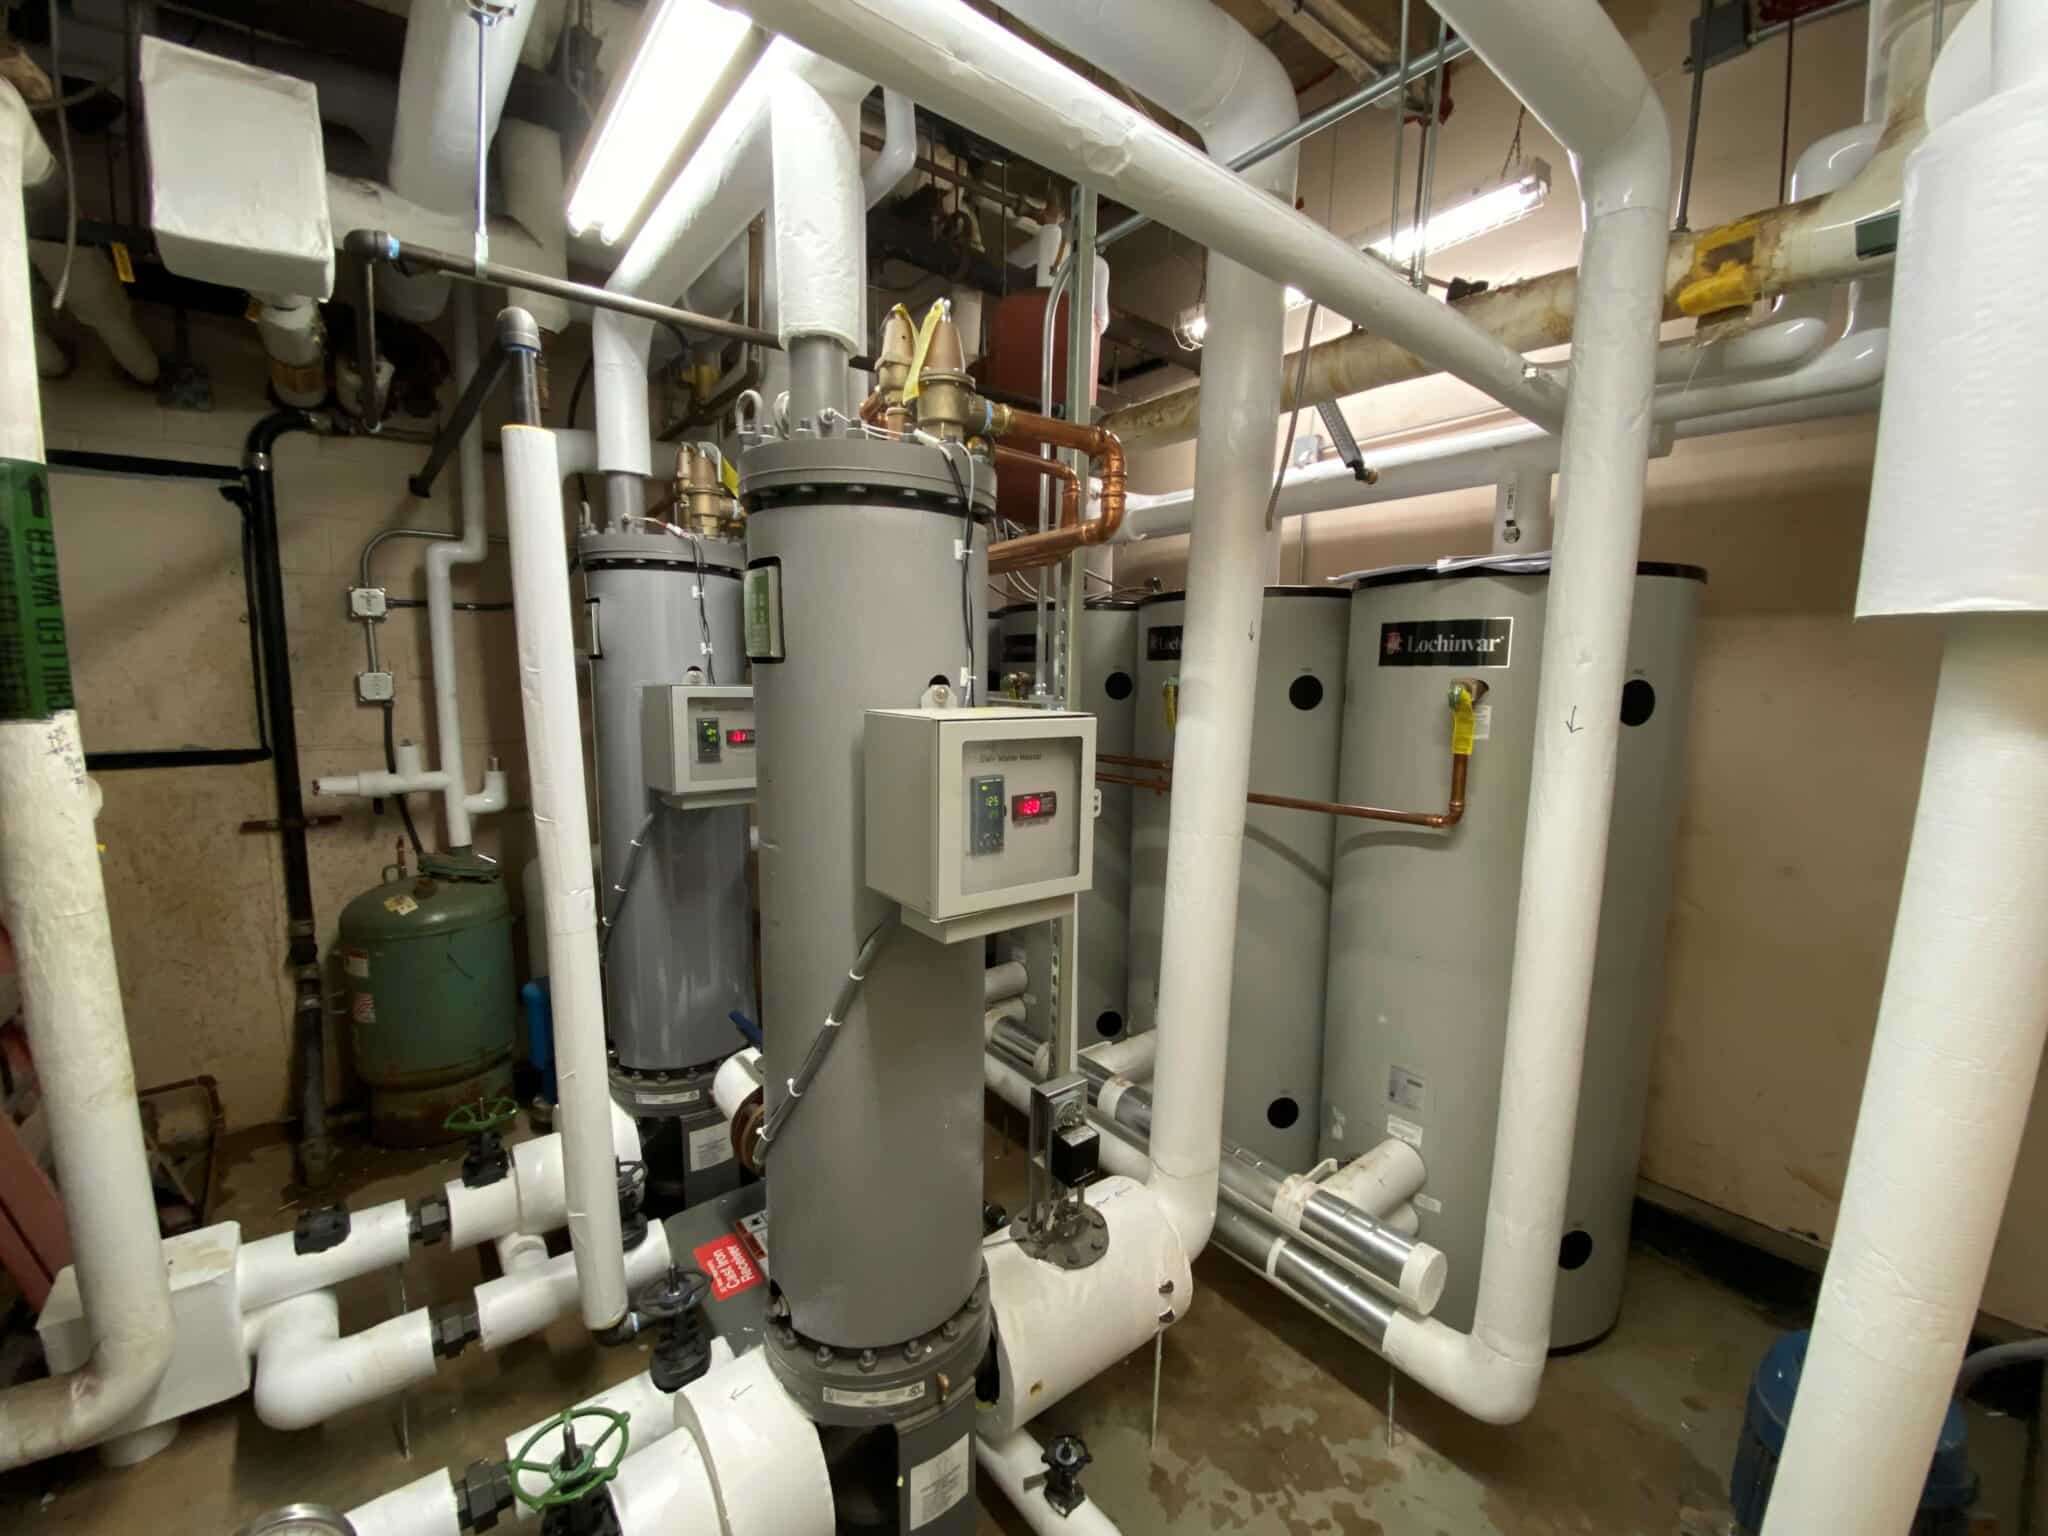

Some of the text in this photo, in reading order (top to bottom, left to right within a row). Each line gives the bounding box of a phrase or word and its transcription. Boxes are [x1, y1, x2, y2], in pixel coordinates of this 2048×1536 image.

[25, 528, 62, 607] WATER
[37, 617, 75, 710] CHILLED
[1407, 634, 1502, 653] Lochinvar
